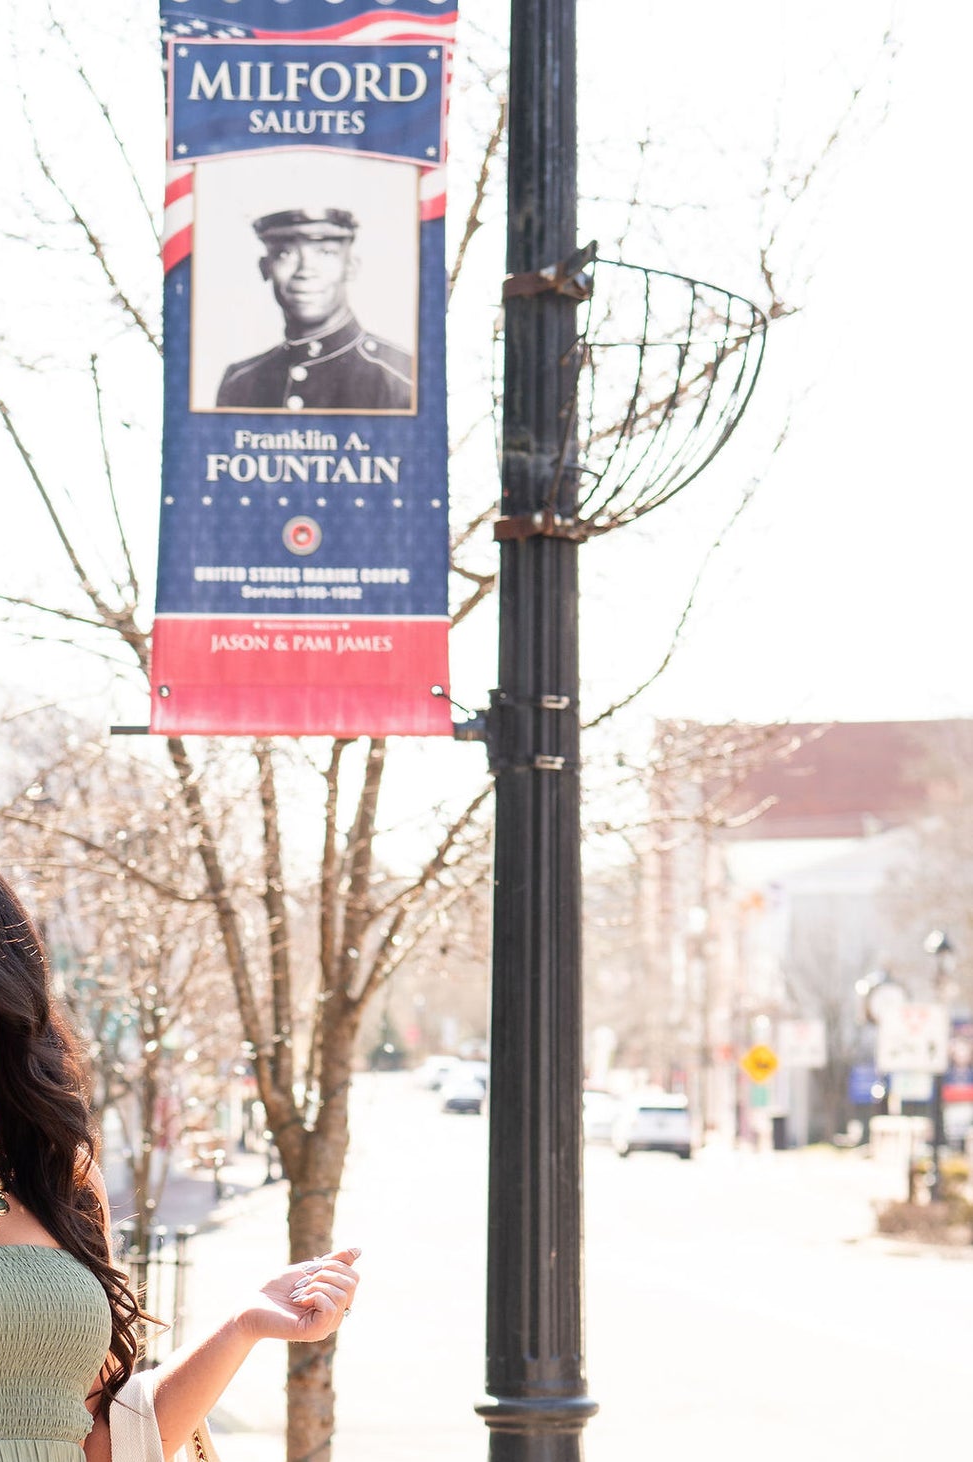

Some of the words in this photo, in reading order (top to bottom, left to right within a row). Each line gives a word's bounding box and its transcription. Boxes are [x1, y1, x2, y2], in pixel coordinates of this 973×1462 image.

[188, 61, 427, 102] MILFORD
[249, 109, 366, 134] SALUTES
[235, 430, 337, 450] Franklin
[344, 432, 370, 451] A.
[206, 454, 401, 484] FOUNTAIN
[194, 566, 247, 582] UNITED
[248, 567, 301, 583] STATES
[302, 567, 359, 583] MARINE
[360, 568, 410, 584] CORPS
[211, 634, 269, 654] JASON
[273, 634, 289, 651] &
[292, 635, 332, 652] PAM
[336, 635, 394, 655] JAMES
